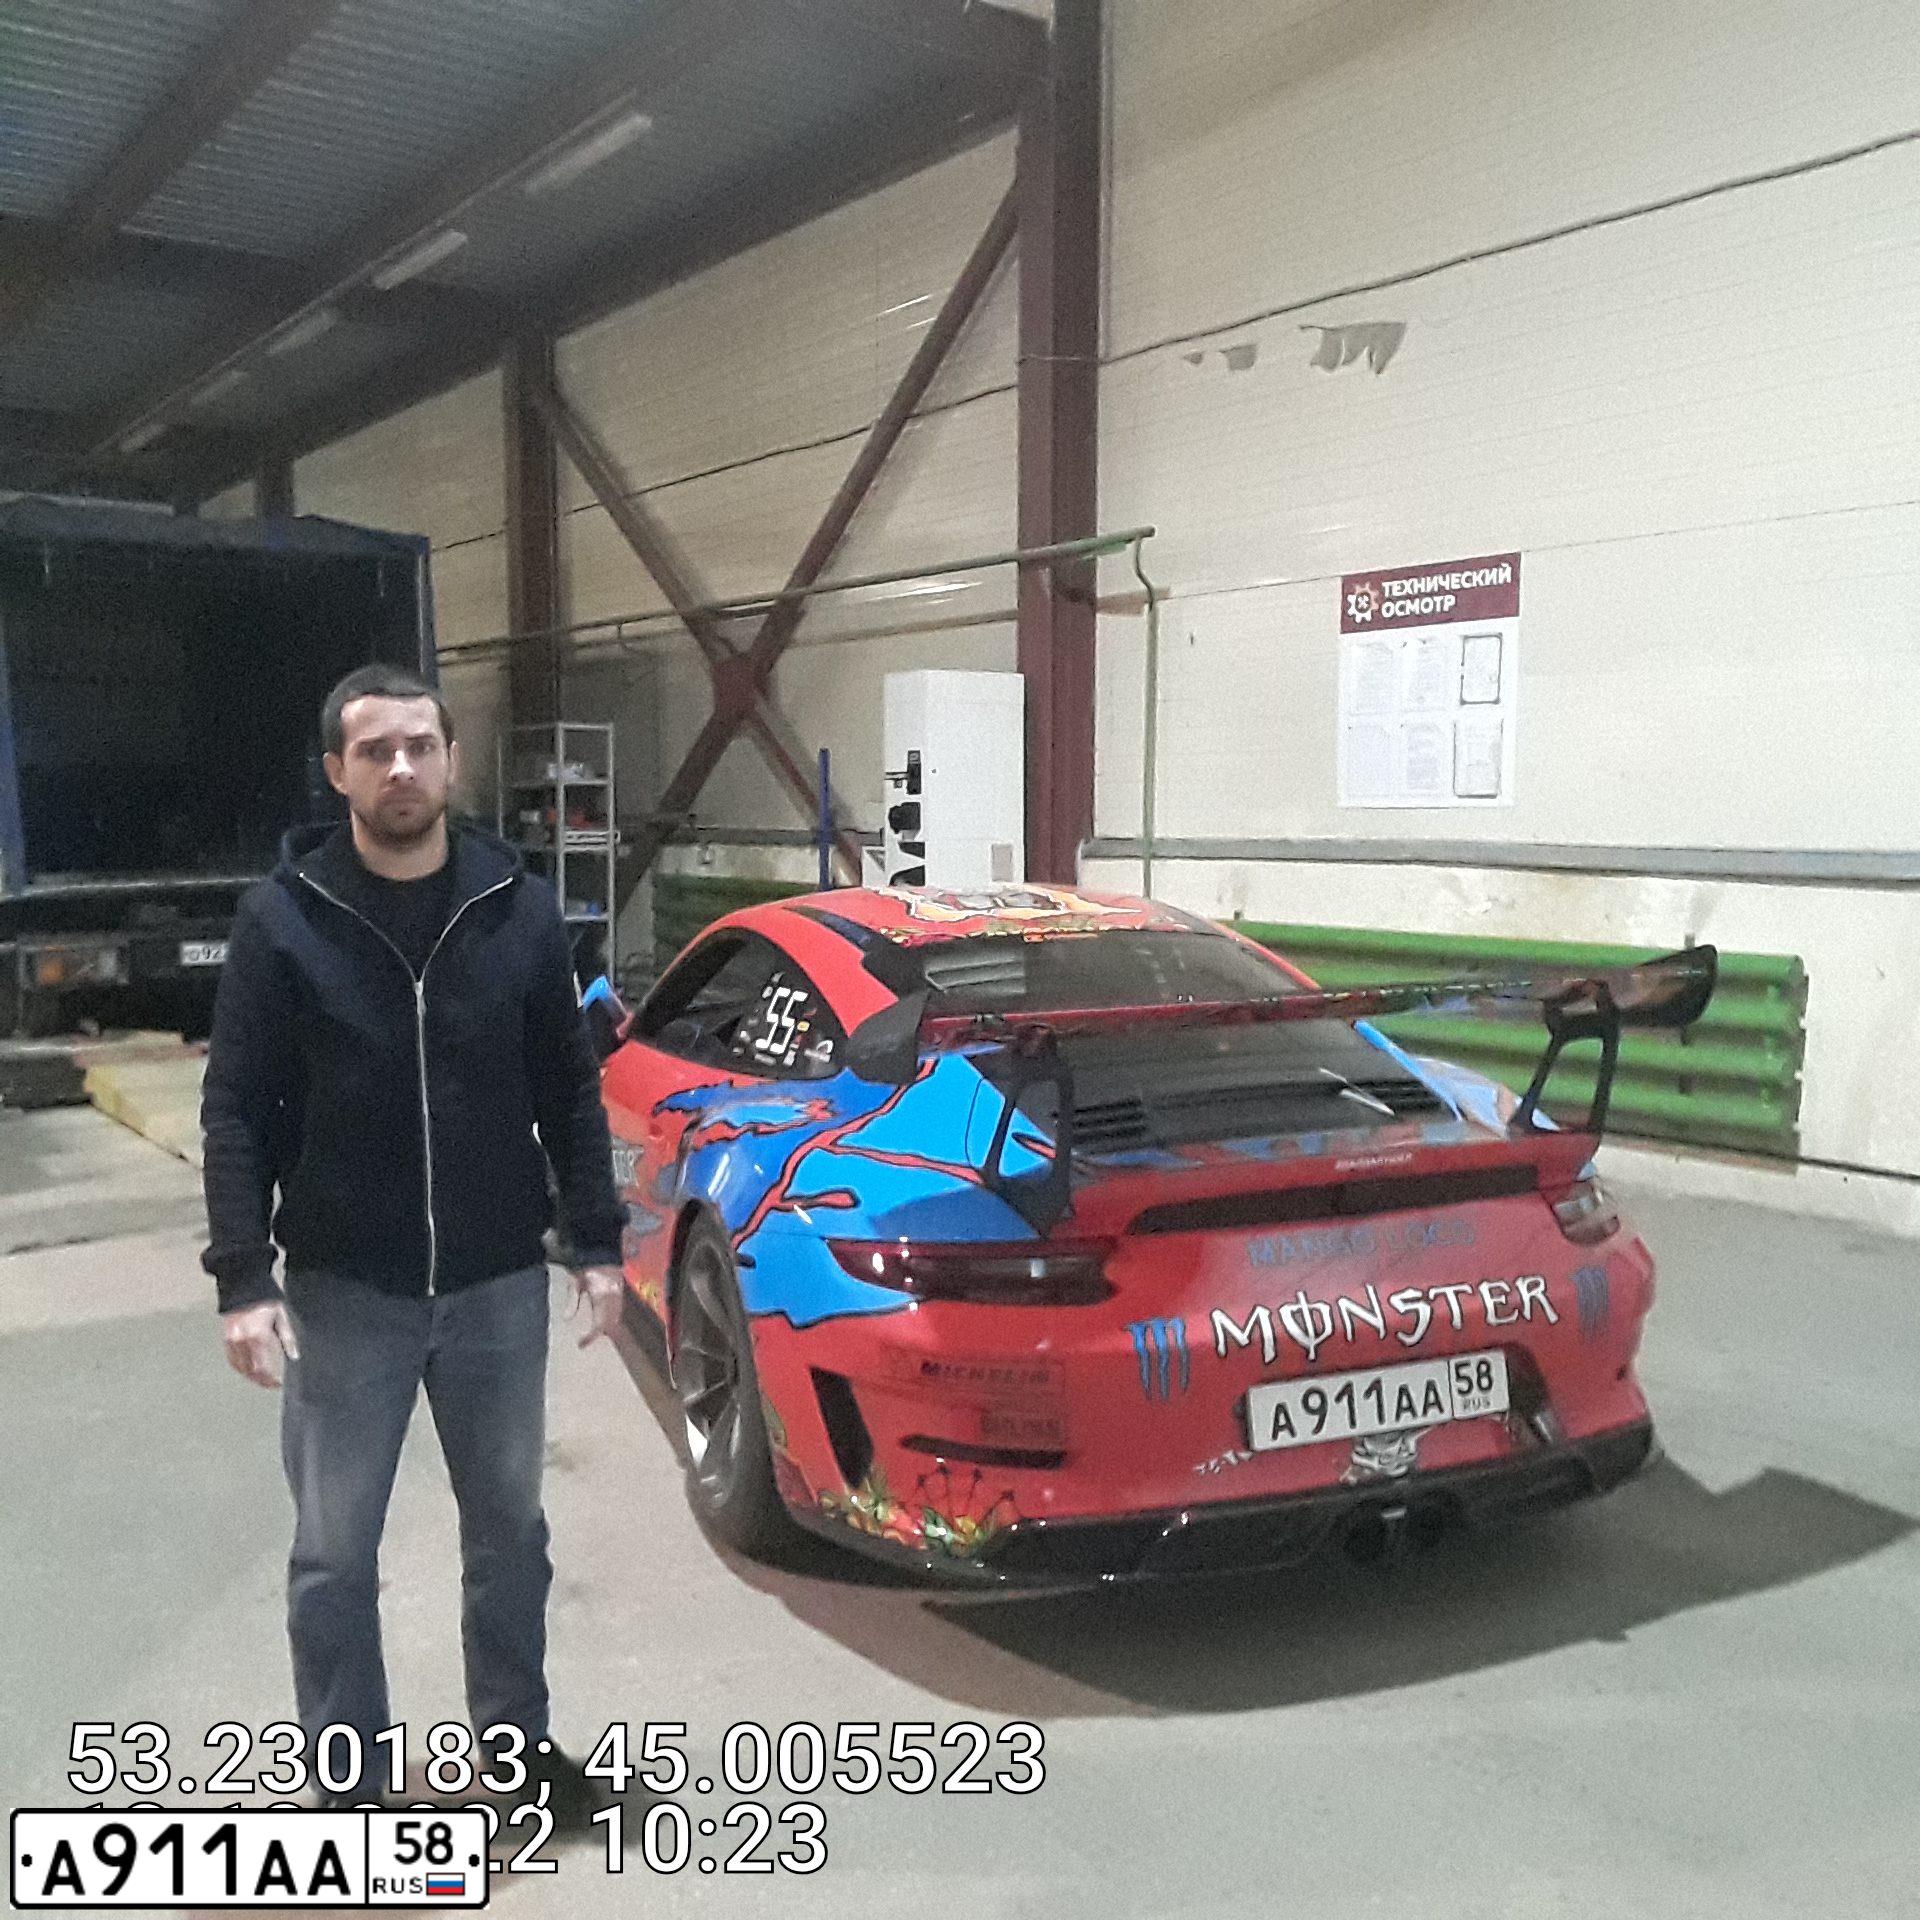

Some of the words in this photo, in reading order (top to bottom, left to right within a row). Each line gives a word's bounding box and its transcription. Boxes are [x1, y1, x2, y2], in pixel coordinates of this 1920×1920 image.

[1381, 563, 1512, 598] ТЕХНИЧЕСКИЙ
[1381, 595, 1456, 619] ОСМОТР
[1210, 1274, 1558, 1364] MONSTER
[1271, 1377, 1445, 1442] А911АА
[1454, 1359, 1494, 1396] 58
